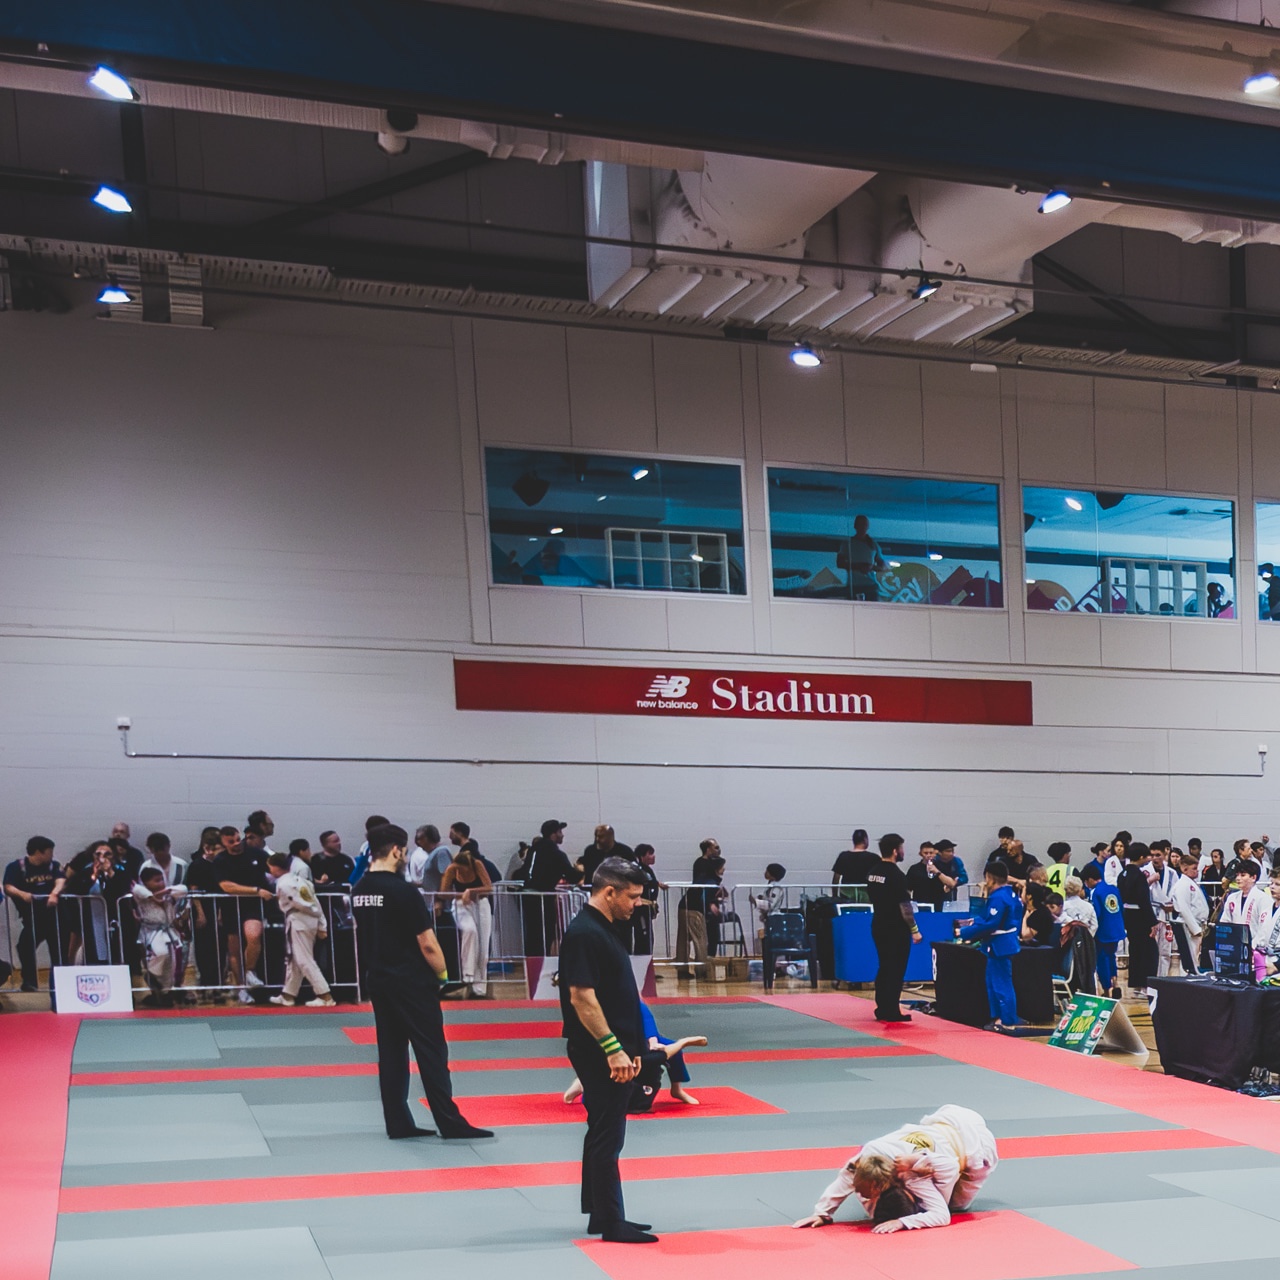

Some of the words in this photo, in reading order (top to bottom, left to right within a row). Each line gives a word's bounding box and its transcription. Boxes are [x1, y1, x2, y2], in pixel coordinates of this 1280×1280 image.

[712, 677, 875, 715] Stadium
[636, 700, 657, 709] new
[658, 700, 699, 710] balance
[1049, 870, 1061, 887] 4
